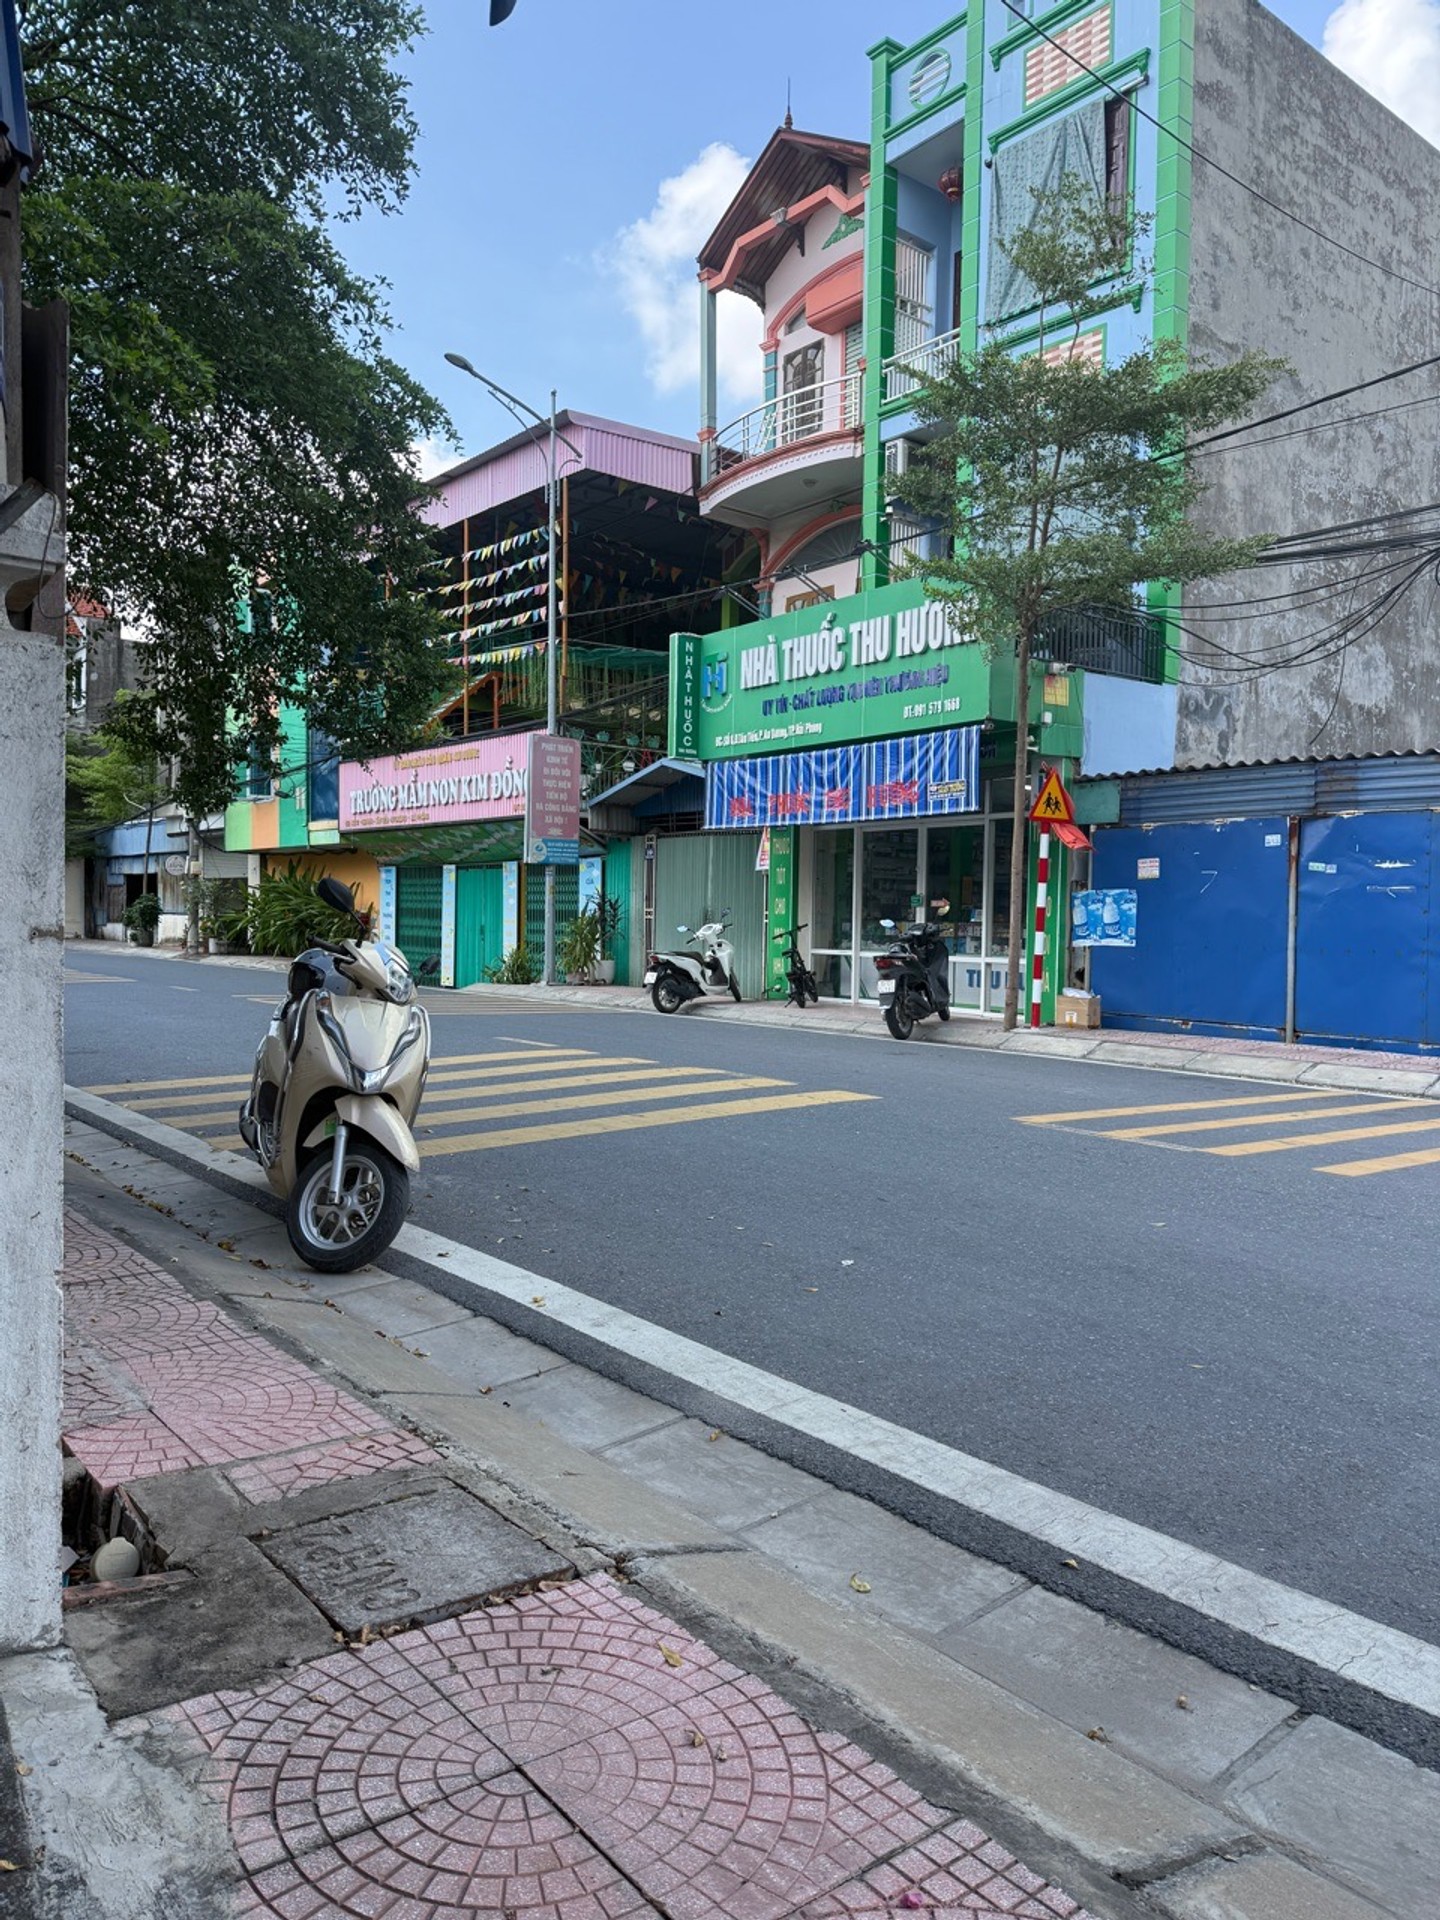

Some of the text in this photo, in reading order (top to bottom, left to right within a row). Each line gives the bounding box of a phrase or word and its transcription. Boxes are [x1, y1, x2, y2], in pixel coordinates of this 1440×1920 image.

[740, 595, 977, 689] NHÀ THUỐC THU HƯƠN
[793, 687, 817, 711] CHẤT
[817, 683, 846, 708] LƯỢNG
[349, 780, 399, 815] TRƯỜNG
[399, 770, 429, 809] MẦM
[430, 777, 458, 805] NON
[459, 773, 490, 802] KIM
